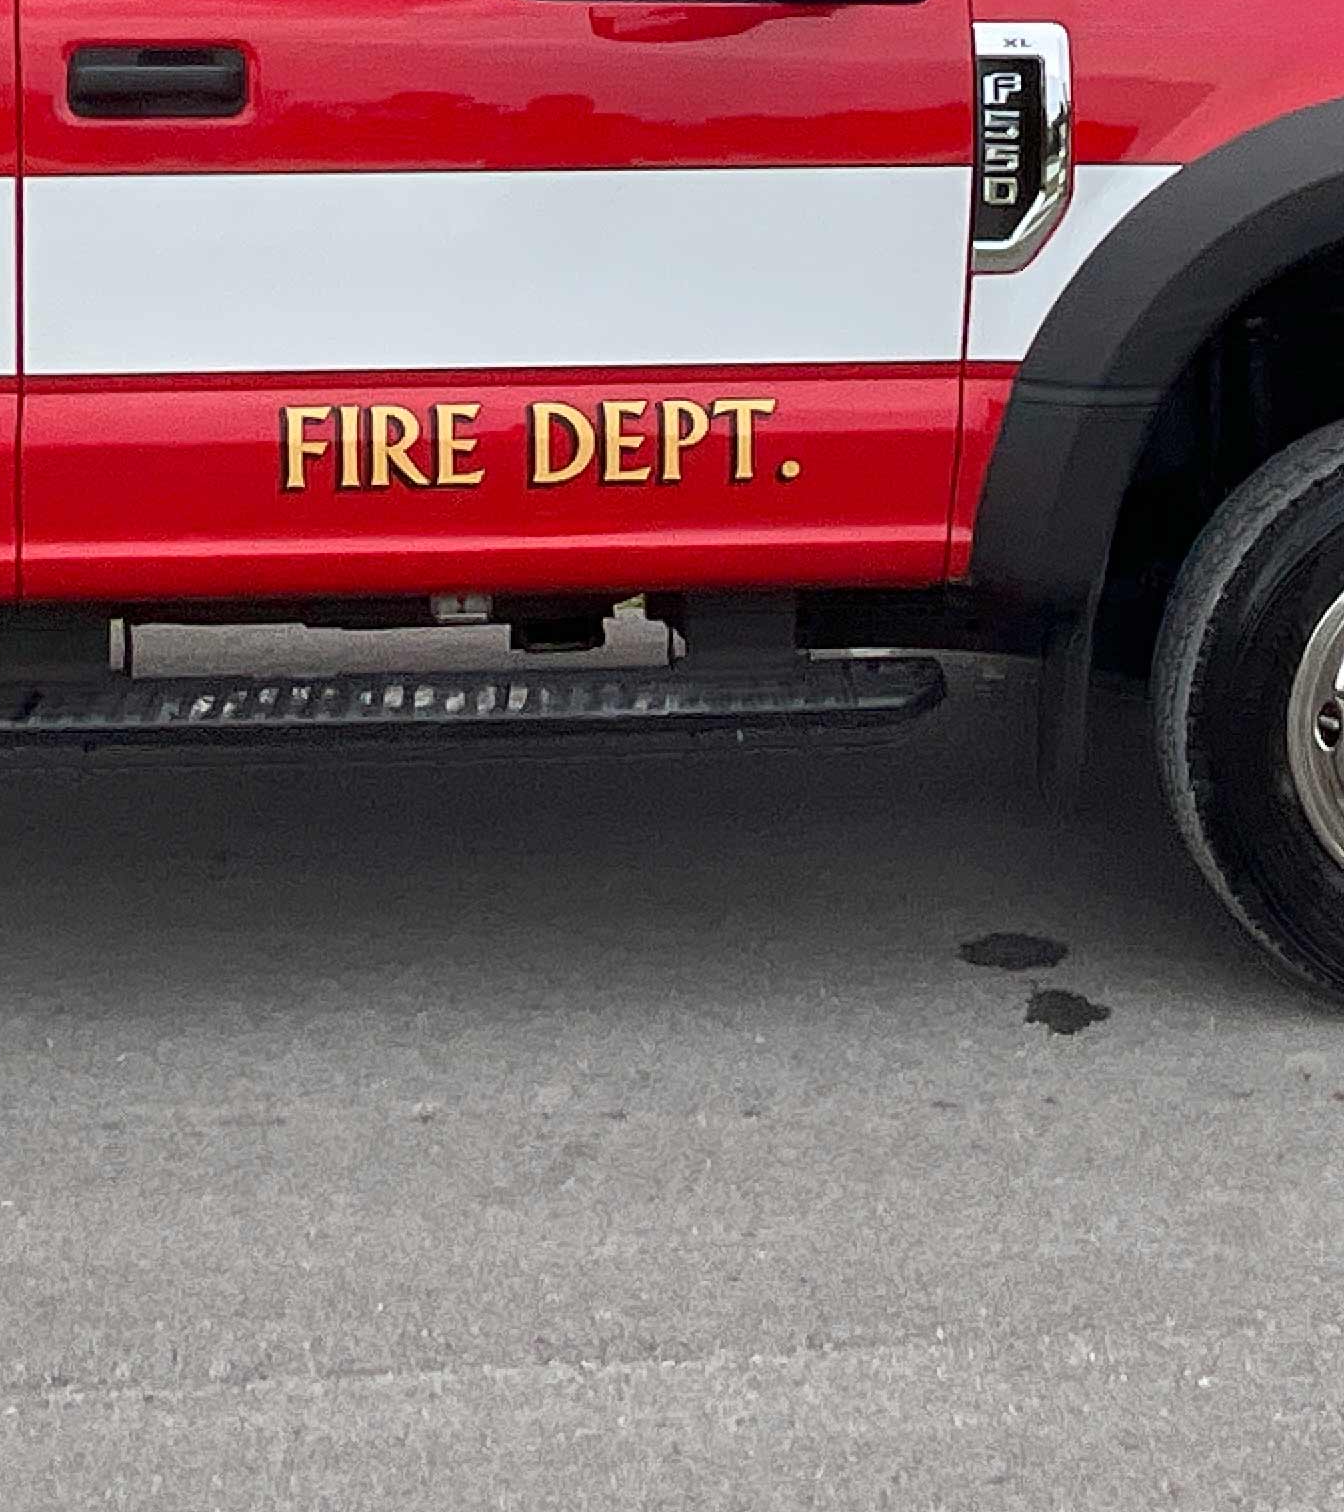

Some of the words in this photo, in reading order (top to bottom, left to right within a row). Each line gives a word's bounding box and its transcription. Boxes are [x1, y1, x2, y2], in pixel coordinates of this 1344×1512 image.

[1002, 38, 1033, 48] XL
[982, 71, 1023, 207] F550
[281, 402, 485, 489] FIRE
[529, 398, 802, 487] DEPT.
